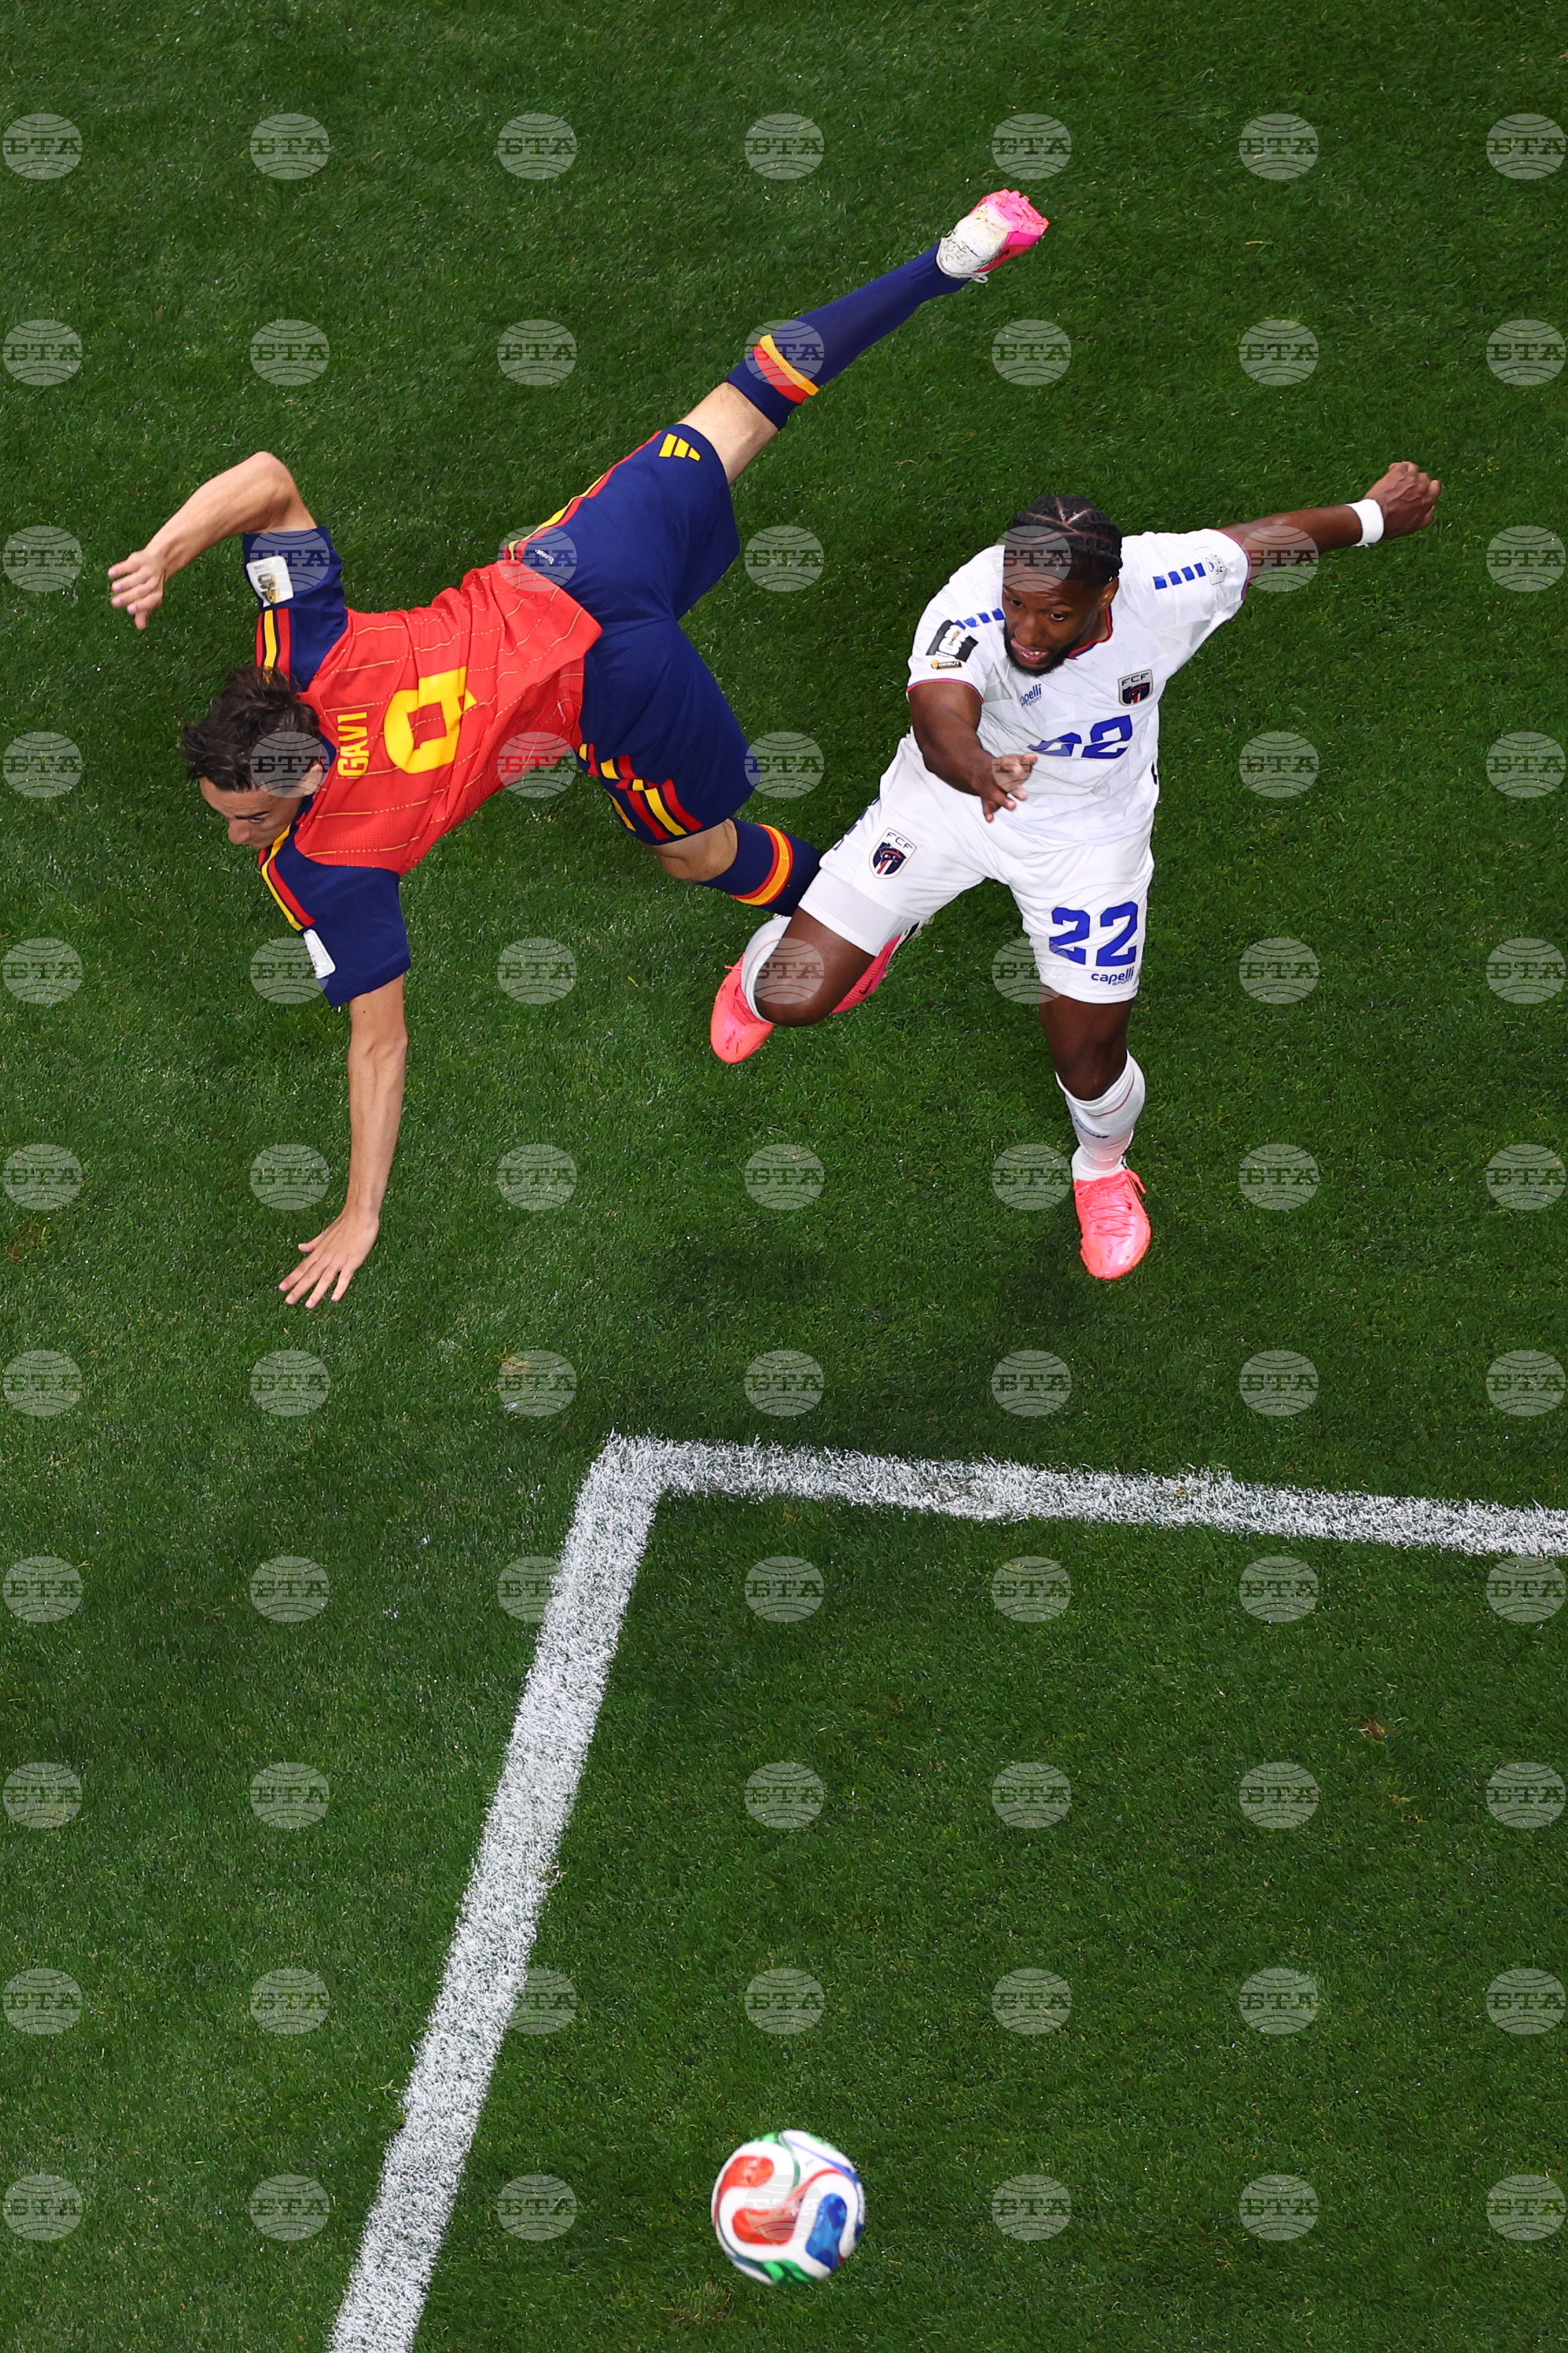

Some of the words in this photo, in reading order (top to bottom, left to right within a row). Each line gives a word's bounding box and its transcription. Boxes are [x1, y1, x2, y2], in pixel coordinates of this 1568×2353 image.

[1122, 673, 1149, 686] FCF
[337, 711, 370, 776] GAVI
[886, 831, 913, 849] FCF
[1049, 901, 1139, 967] 22
[1091, 966, 1135, 984] capelli
